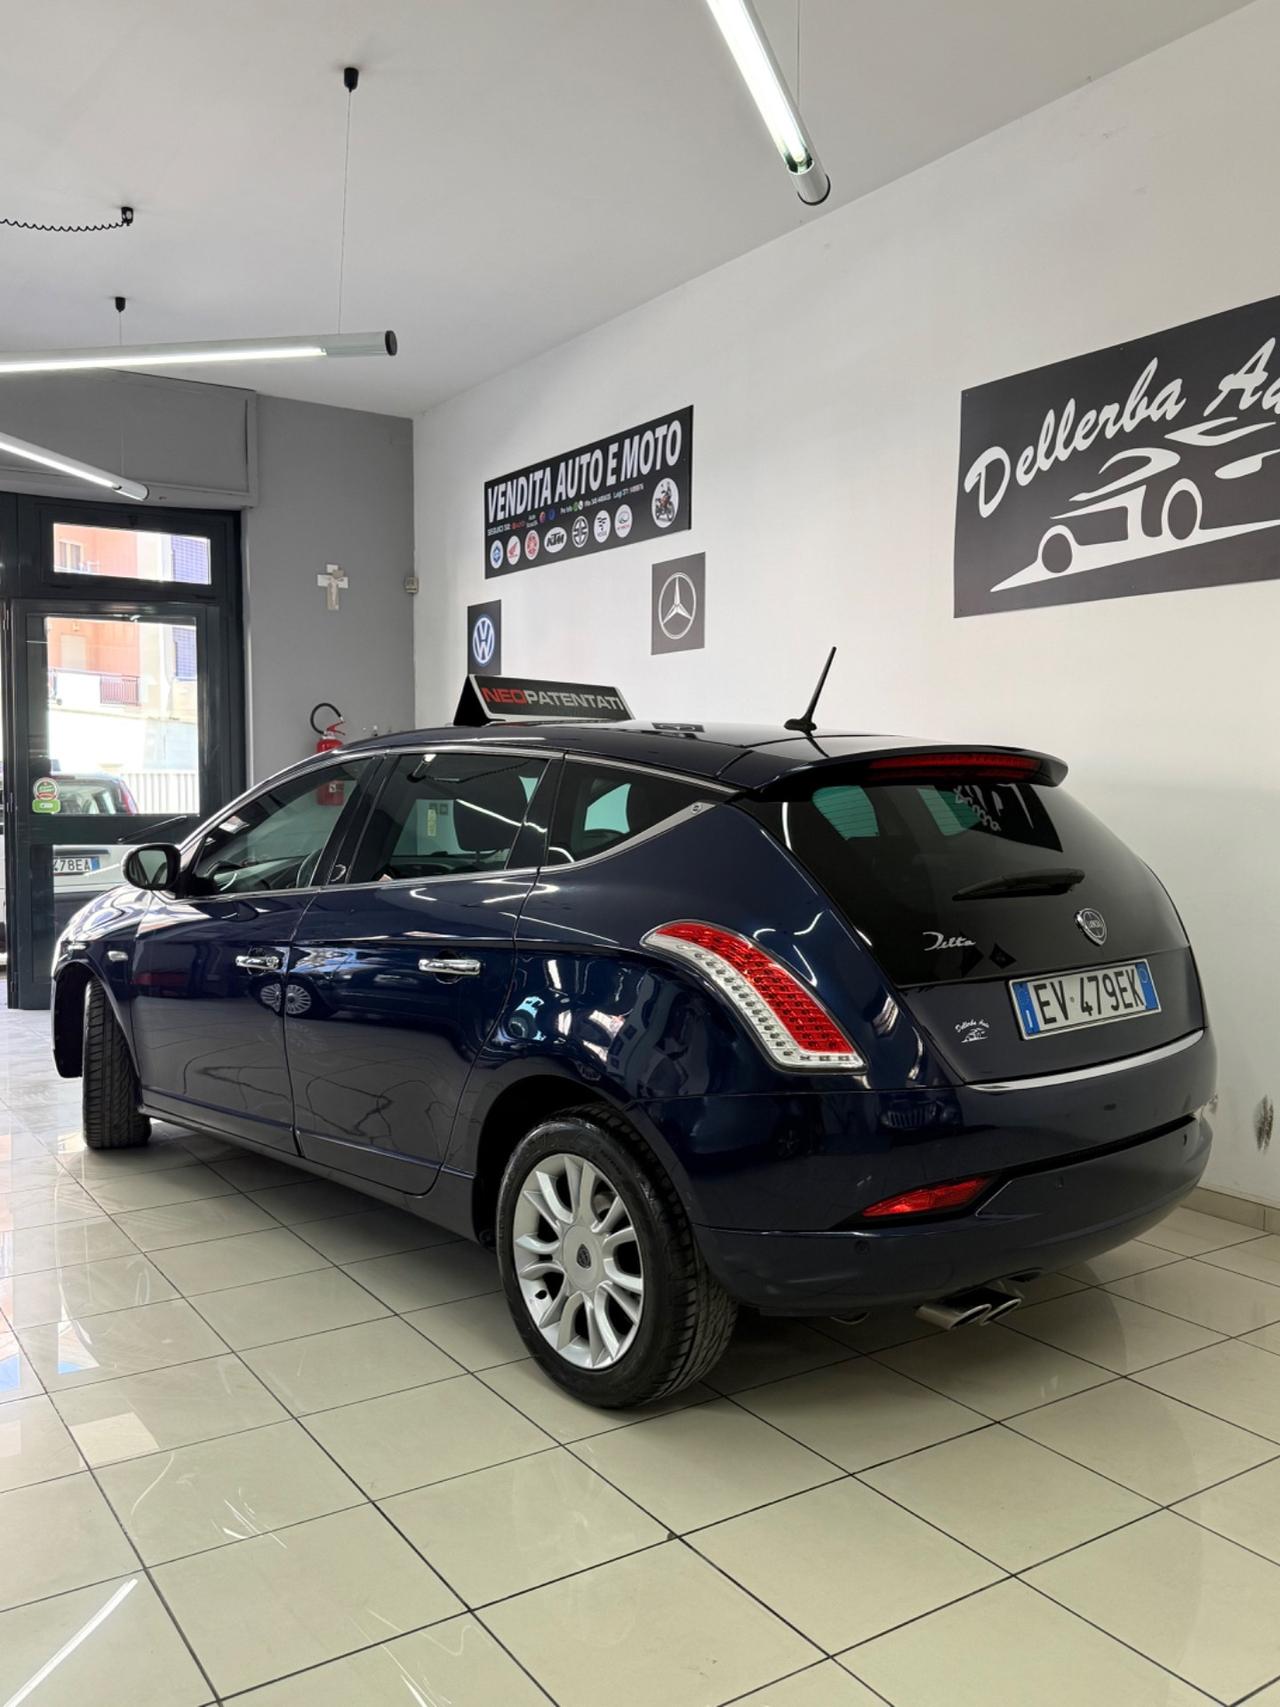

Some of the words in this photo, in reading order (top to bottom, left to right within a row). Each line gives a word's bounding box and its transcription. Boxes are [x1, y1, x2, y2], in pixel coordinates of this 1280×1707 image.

[964, 357, 1187, 519] Dellerba
[488, 467, 552, 523] VENDITA
[554, 448, 604, 503] AUTO
[606, 442, 619, 487] E
[620, 420, 682, 482] MOTO
[546, 532, 565, 547] KTM
[481, 687, 625, 711] NEOPATENTATI
[922, 931, 977, 951] Delta
[1034, 980, 1069, 1024] EV
[1080, 968, 1145, 1016] 479EK
